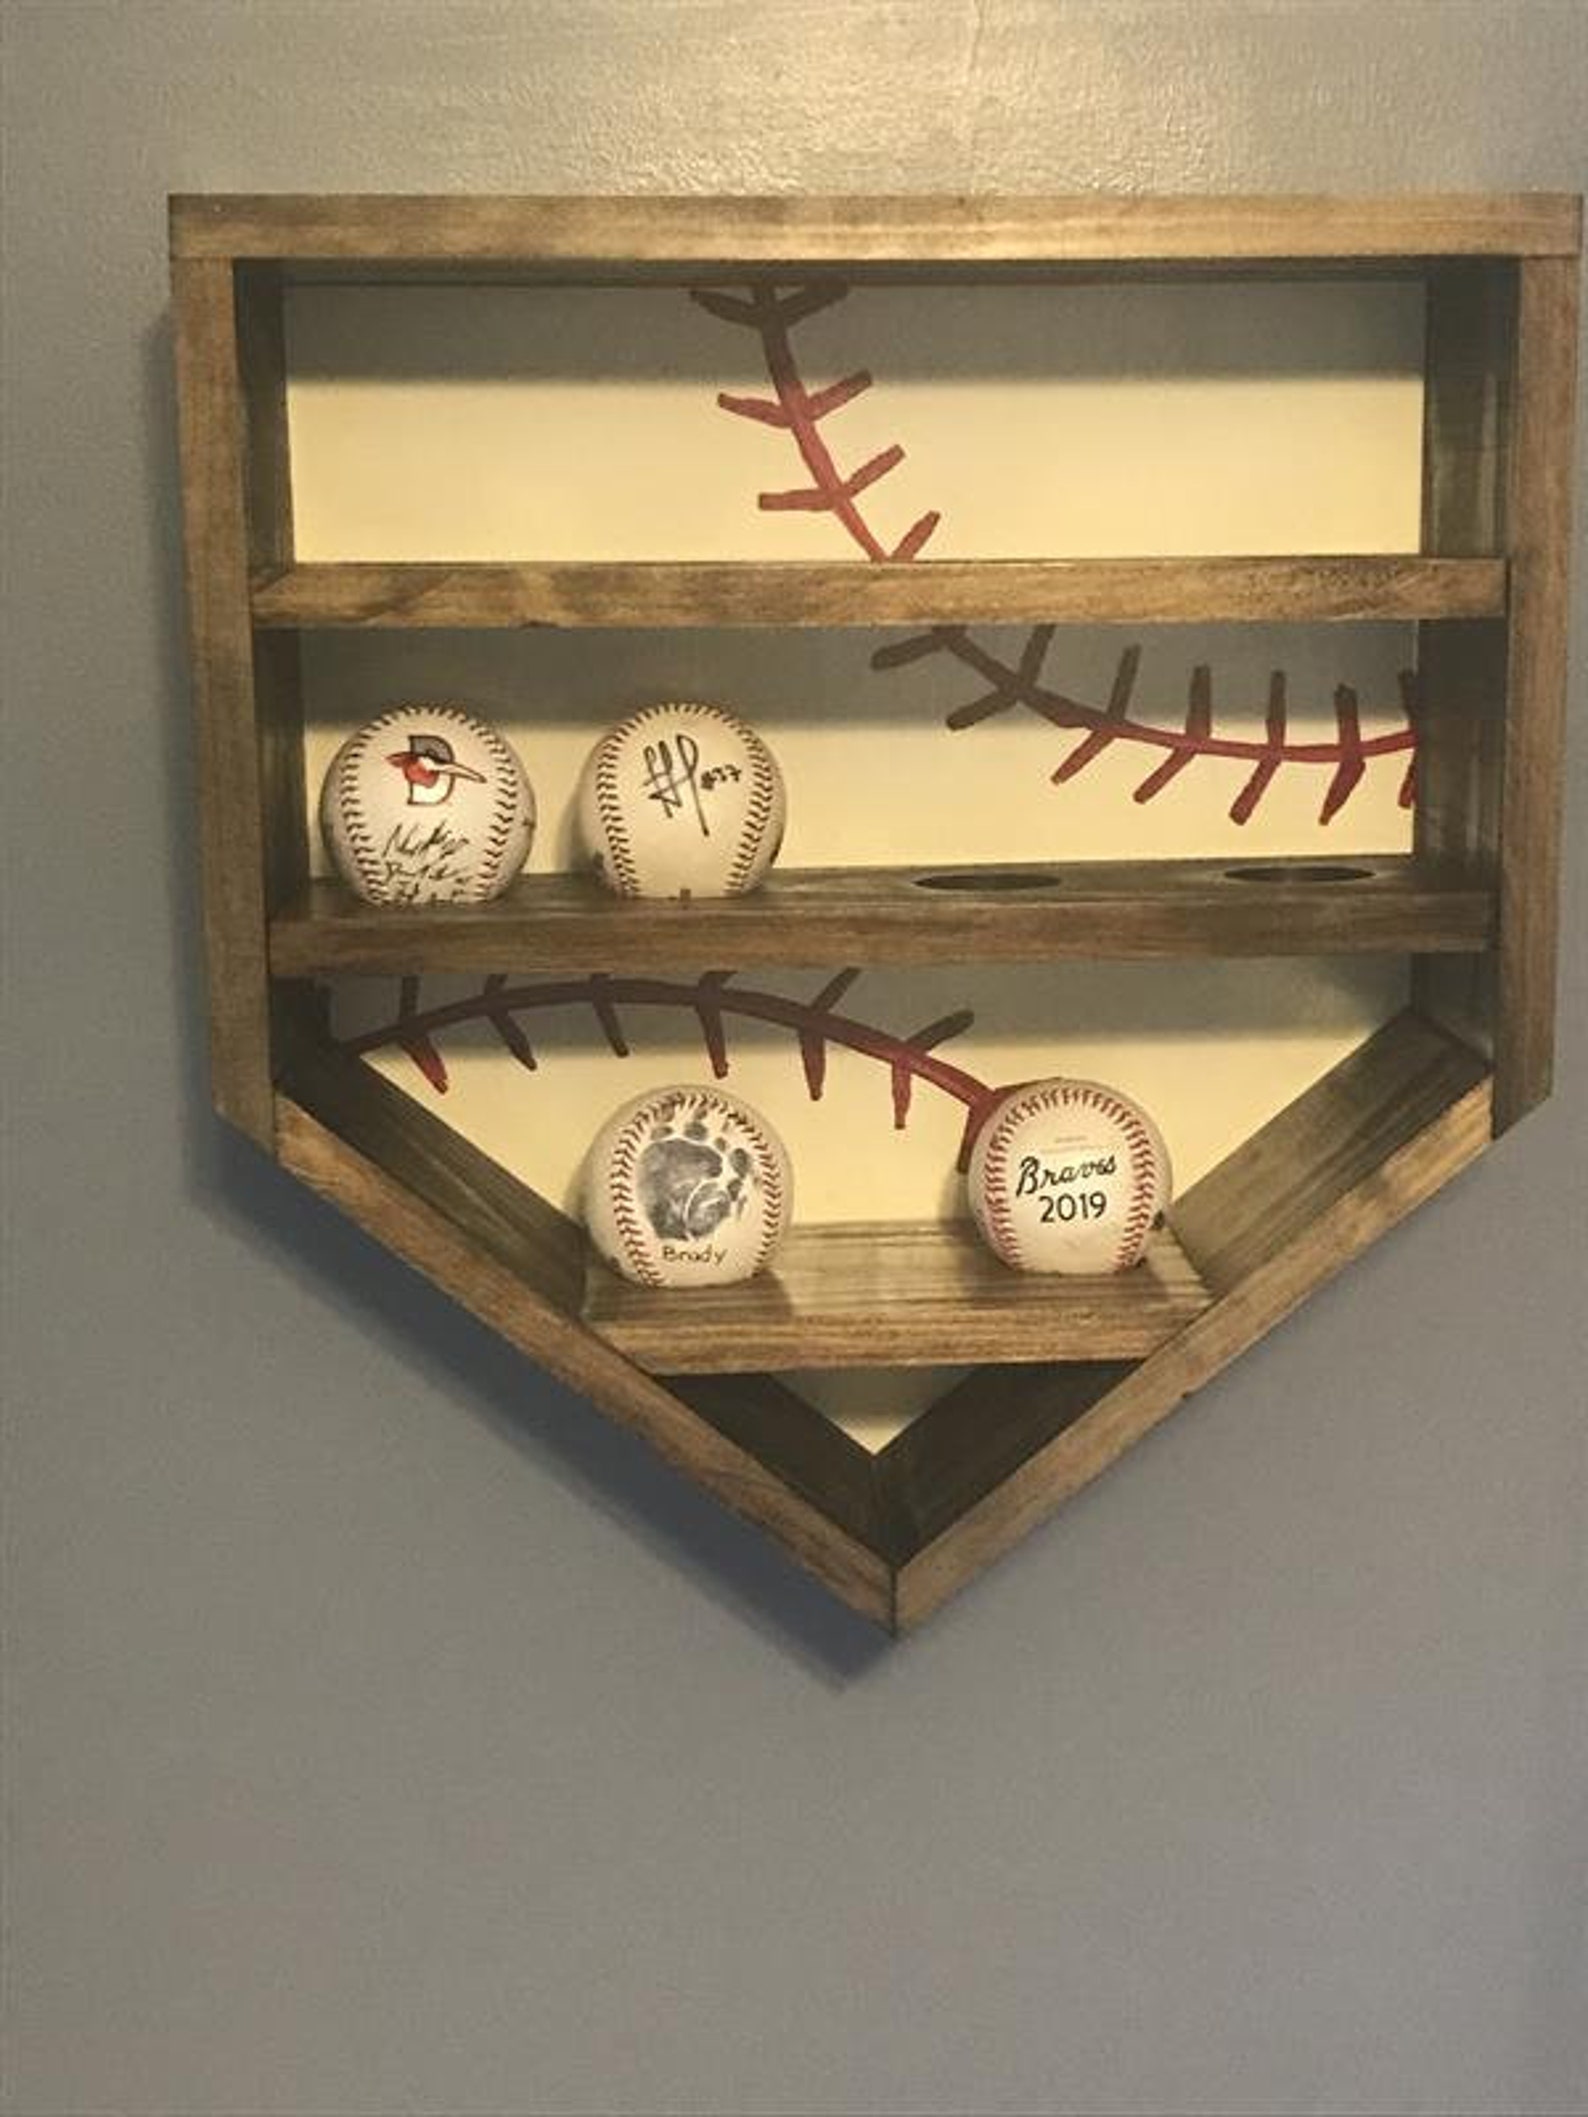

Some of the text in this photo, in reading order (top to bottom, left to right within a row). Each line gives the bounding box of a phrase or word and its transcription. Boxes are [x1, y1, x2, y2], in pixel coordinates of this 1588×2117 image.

[1016, 1155, 1117, 1197] Braves
[1038, 1191, 1107, 1223] 2019
[662, 1243, 727, 1265] Brady
